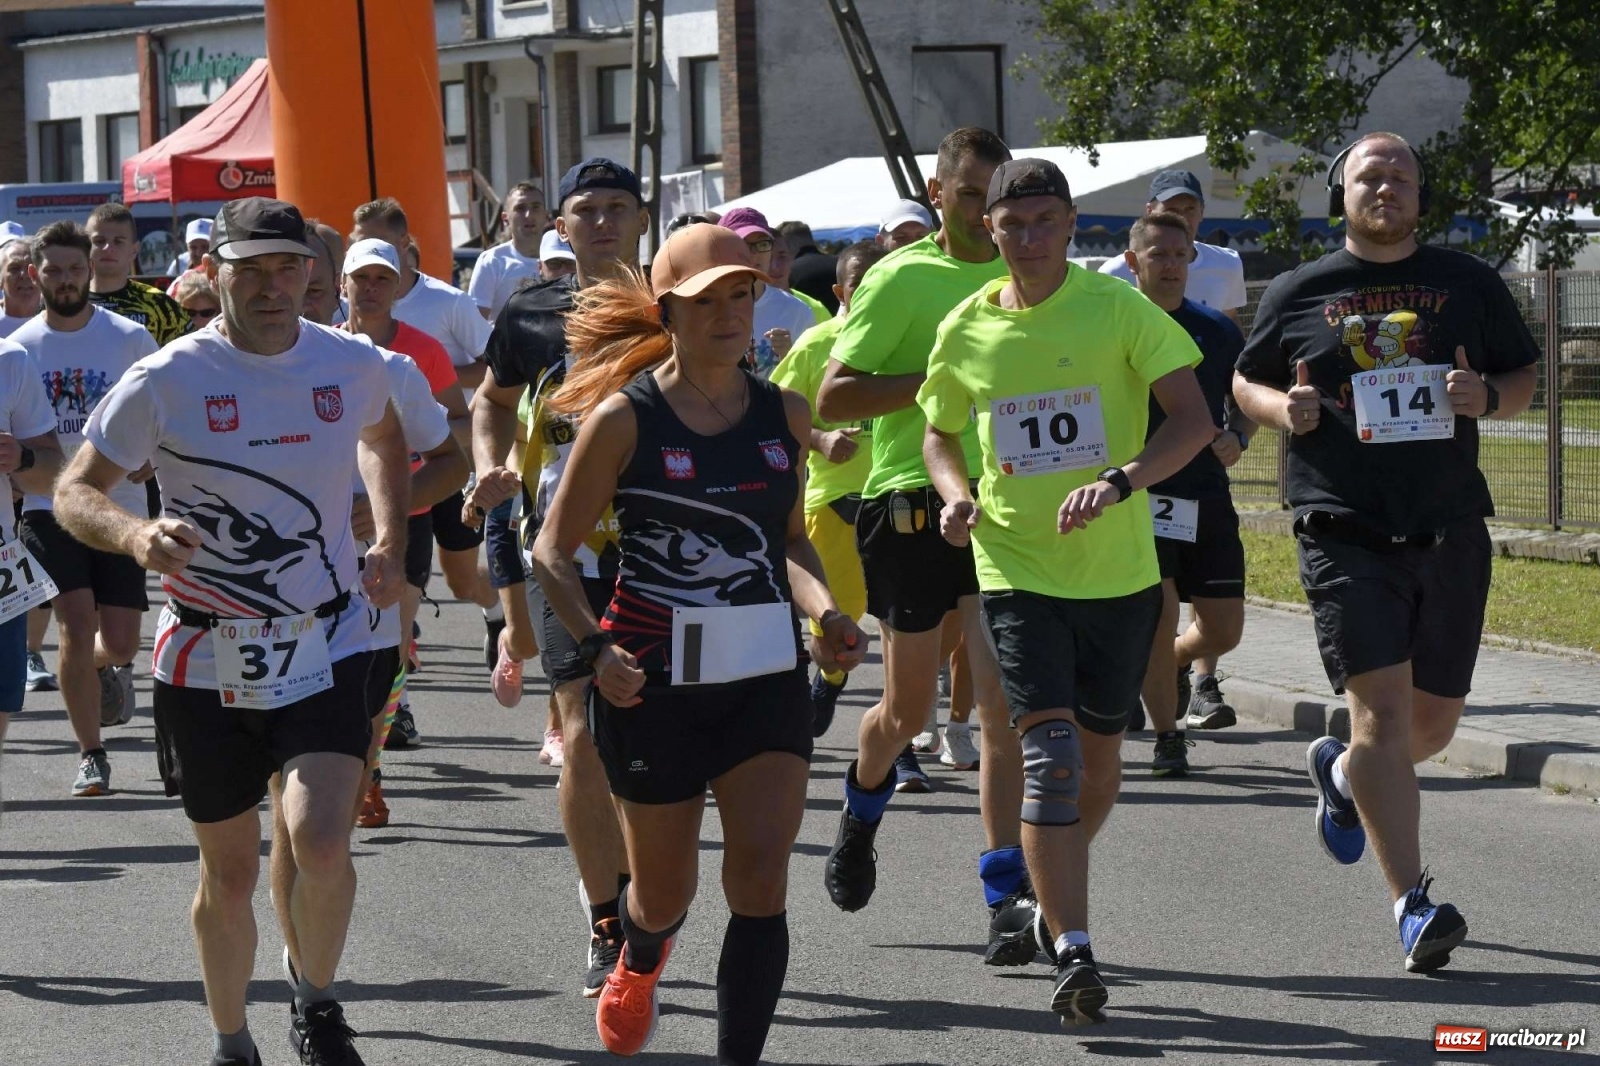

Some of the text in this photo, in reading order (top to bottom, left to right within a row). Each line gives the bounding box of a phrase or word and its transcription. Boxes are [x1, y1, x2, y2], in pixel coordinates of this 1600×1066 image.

[1357, 284, 1415, 295] ACCORDING TO
[1324, 292, 1450, 327] CHEMISTRY
[1361, 369, 1447, 387] COLOUR RUN
[998, 391, 1092, 416] COLOUR RUN
[1380, 386, 1436, 418] 14
[1019, 412, 1079, 449] 10
[1154, 498, 1174, 521] 2
[220, 617, 314, 640] COLOUR RUN
[238, 639, 298, 681] 37
